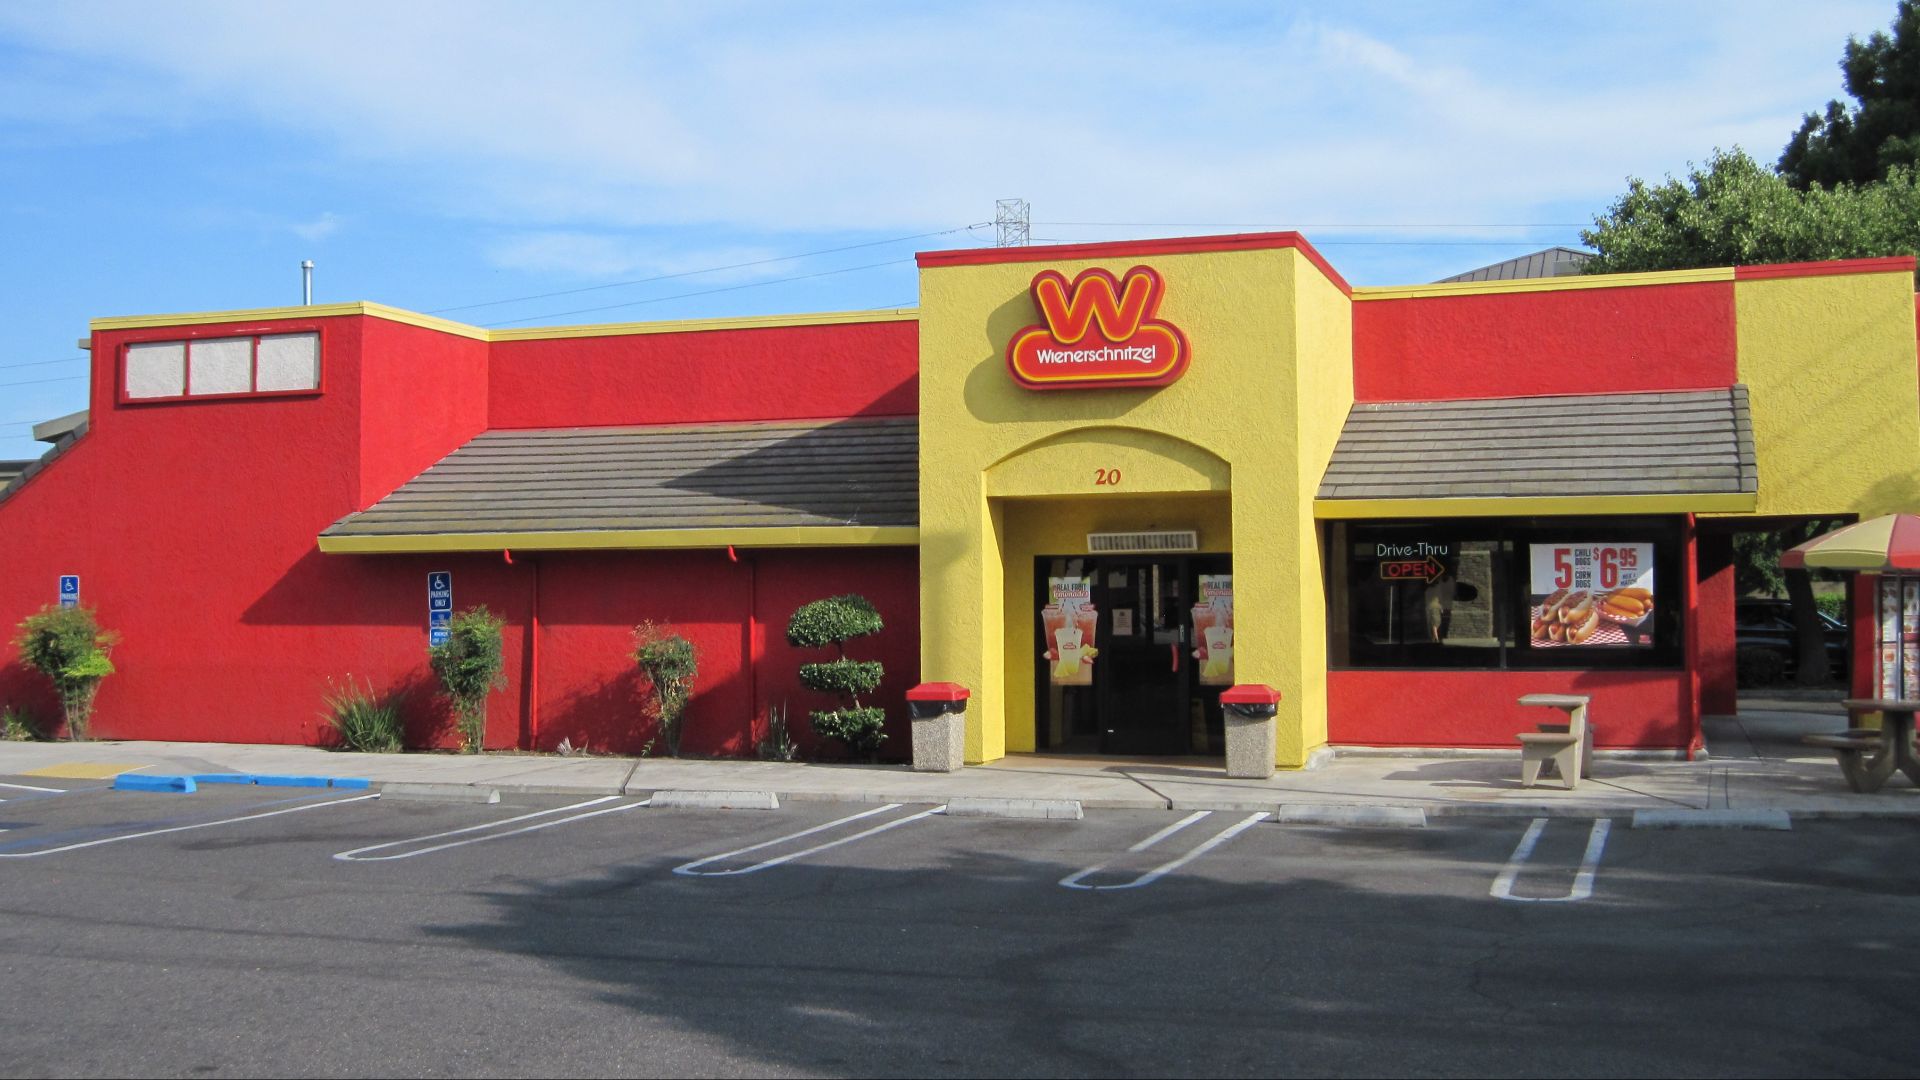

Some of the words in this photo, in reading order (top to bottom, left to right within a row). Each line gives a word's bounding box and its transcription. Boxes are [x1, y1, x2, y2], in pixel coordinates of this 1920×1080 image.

[1037, 345, 1155, 364] Wienerschnitzel
[1095, 468, 1121, 486] 20
[1377, 542, 1448, 557] Drive-Thru
[1574, 549, 1591, 557] CHILI
[1574, 558, 1591, 566] DOGS
[1388, 563, 1436, 577] OPEN
[1554, 548, 1572, 588] 5
[1575, 571, 1591, 580] CORN
[1057, 583, 1070, 591] REAL
[1071, 583, 1086, 591] FRUIT
[1575, 580, 1591, 588] DOGS
[431, 590, 450, 599] PARKING
